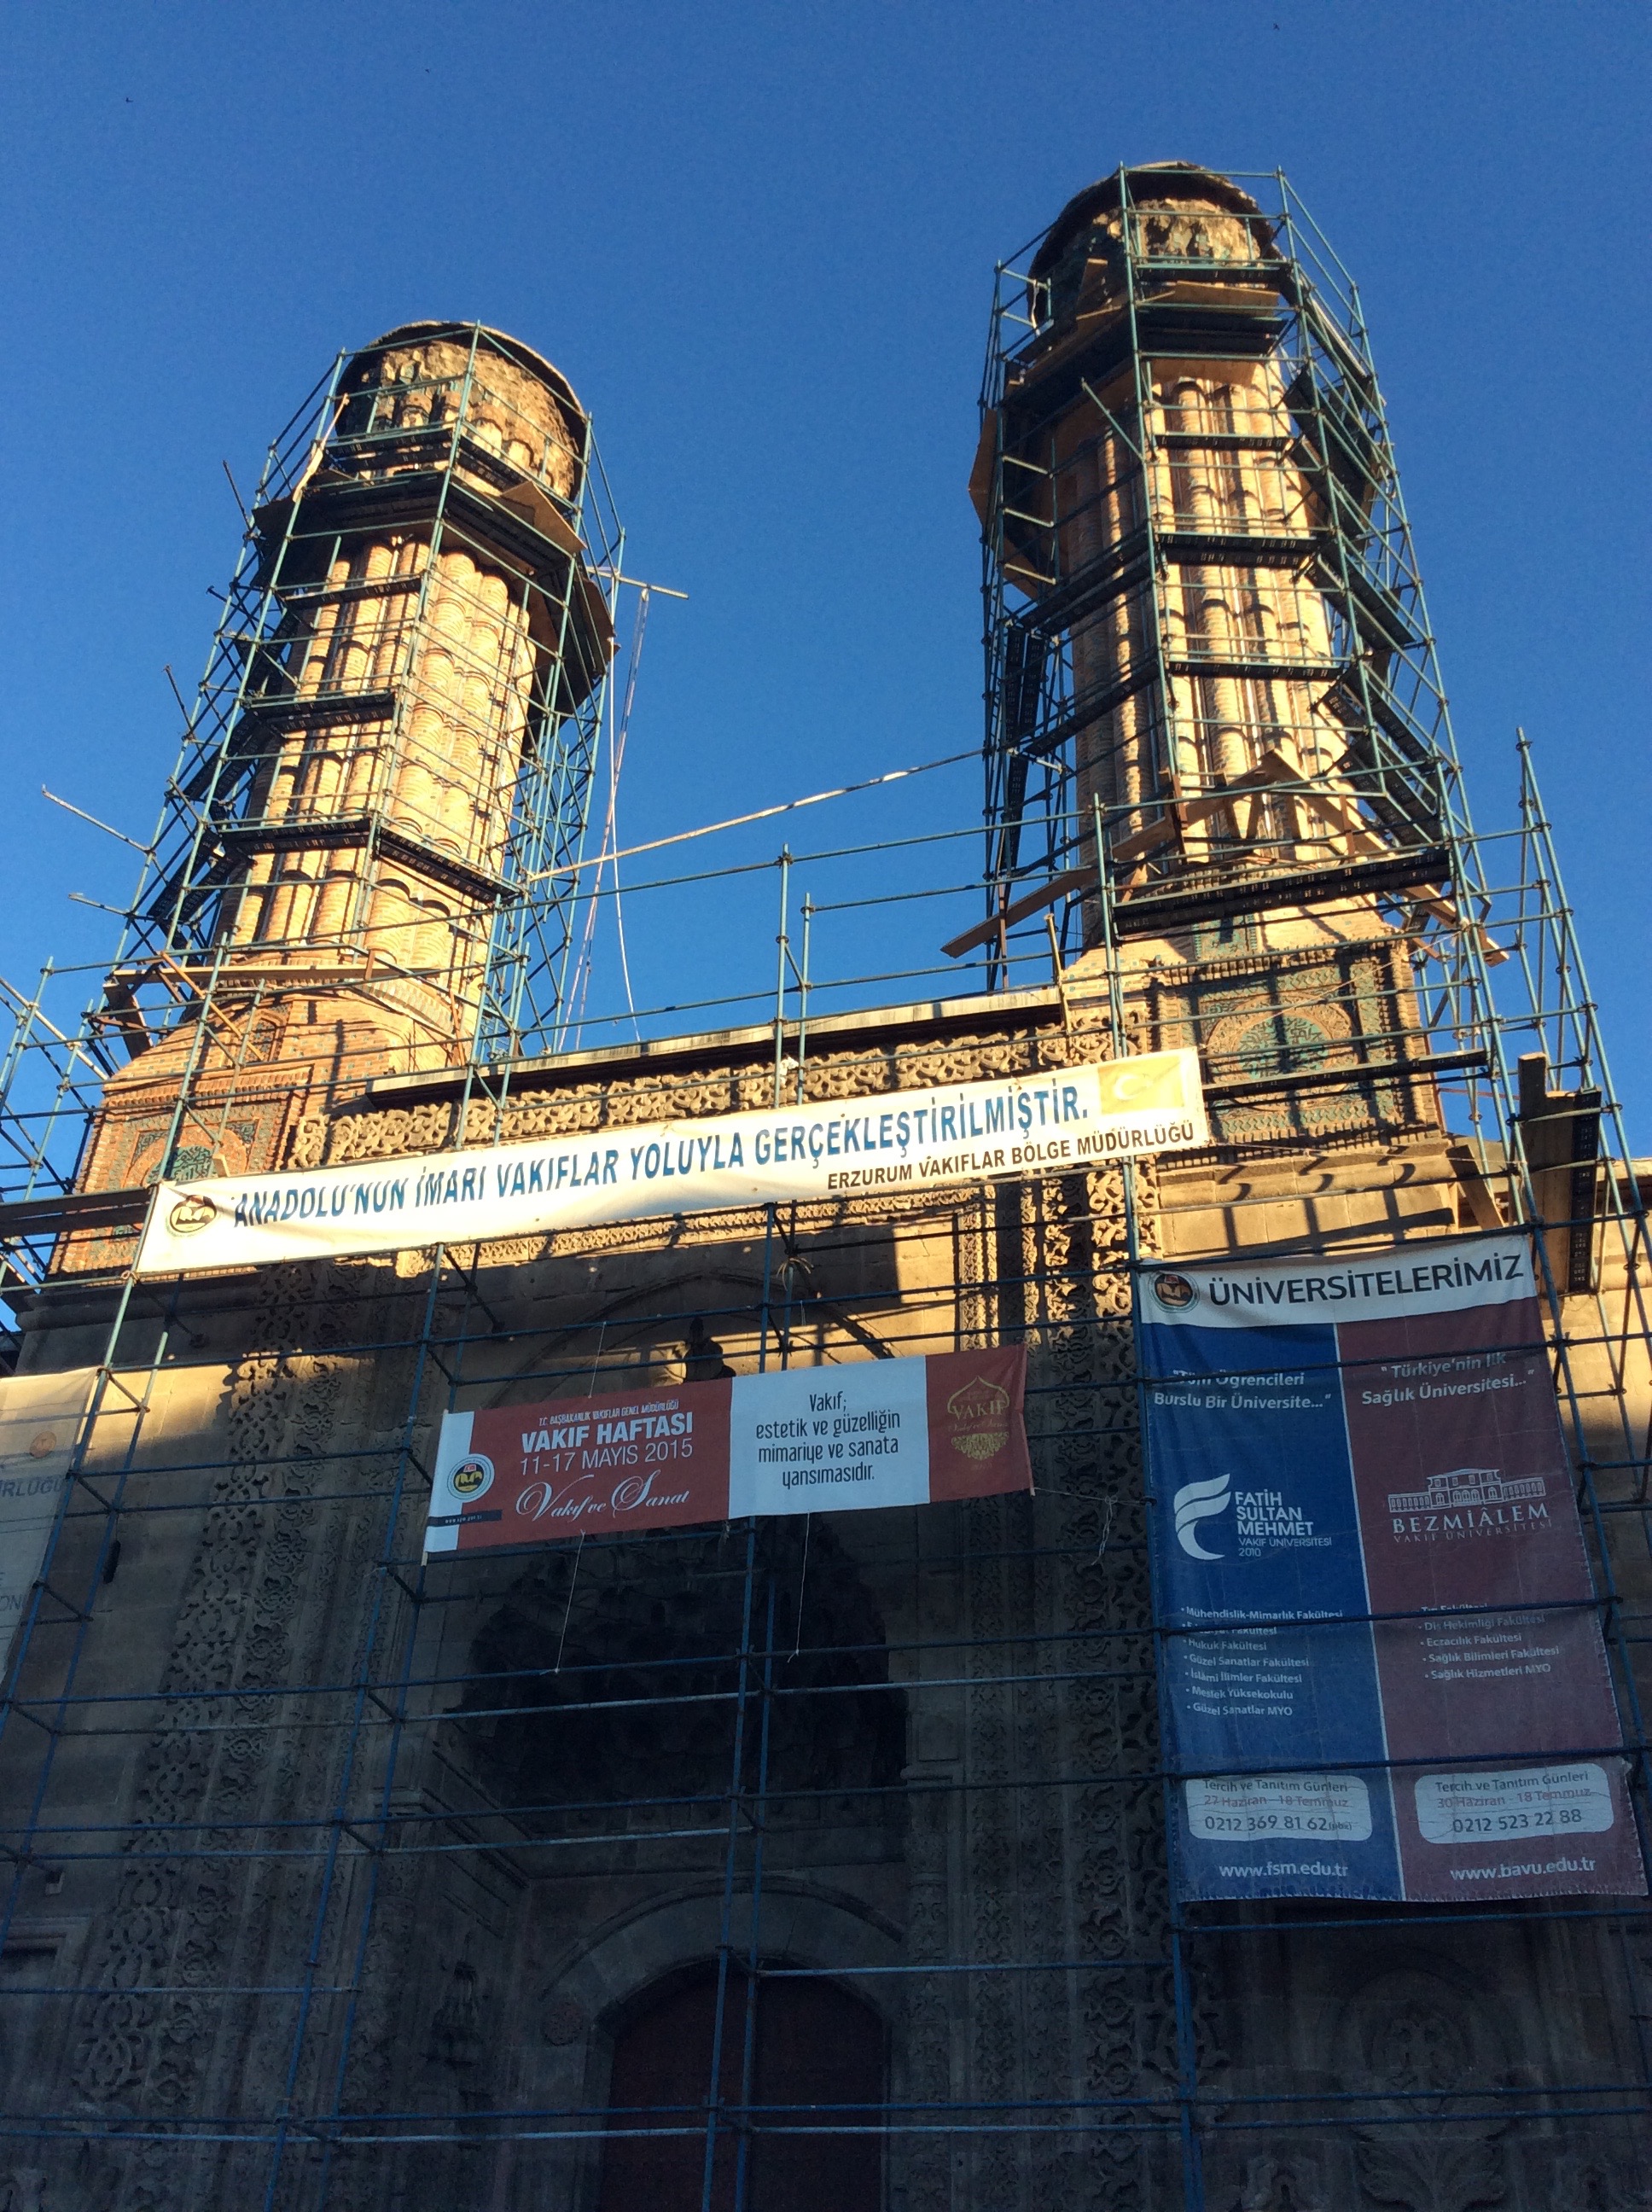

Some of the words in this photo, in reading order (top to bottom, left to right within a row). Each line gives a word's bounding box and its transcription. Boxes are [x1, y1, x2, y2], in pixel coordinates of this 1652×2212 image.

[234, 1177, 409, 1227] ANADOLU'NUN
[416, 1166, 485, 1208] İMARI
[497, 1150, 619, 1197] VAKIFLAR
[631, 1132, 743, 1179] YOLUYLA
[754, 1077, 1088, 1169] GERÇEKLEŞTİRİLMİŞTİR.
[828, 1163, 913, 1190] ERZURUM
[918, 1149, 1005, 1179] VAKIFLAR
[1011, 1138, 1071, 1164] BÖLGE
[1077, 1119, 1194, 1155] MÜDÜRLÜĞÜ
[1209, 1253, 1524, 1306] ÜNİVERSİTELERİMİZ
[810, 1391, 846, 1412] Vakıf;
[1155, 1392, 1201, 1406] Burslu
[1206, 1394, 1226, 1408] Bir
[1363, 1388, 1415, 1406] Sağlık
[952, 1400, 1006, 1420] VAKIF
[521, 1425, 590, 1453] VAKIF
[596, 1412, 693, 1445] HAFTASI
[757, 1418, 808, 1439] estetik
[813, 1420, 829, 1435] ve
[834, 1410, 900, 1437] güzelliğin
[521, 1452, 575, 1476] 11-17
[582, 1445, 638, 1470] MAYIS
[644, 1438, 693, 1463] 2015
[759, 1441, 823, 1464] mimariye
[828, 1443, 844, 1458] ve
[849, 1435, 899, 1457] sanata
[782, 1461, 875, 1489] yansımasıdır.
[515, 1474, 595, 1522] Vakıf
[587, 1501, 606, 1514] ve
[611, 1469, 689, 1518] Sanat
[1235, 1488, 1283, 1506] FATİH
[1236, 1506, 1302, 1521] SULTAN
[1393, 1503, 1550, 1534] BEZMİÂLEM
[1237, 1521, 1314, 1536] MEHMET
[1238, 1537, 1266, 1546] VAKIF
[1393, 1533, 1436, 1543] VAKIF
[1238, 1547, 1261, 1557] 2010
[1186, 1606, 1294, 1620] Mühendislik-Mimarlık
[1497, 1614, 1545, 1627] Fakültesi
[1189, 1639, 1219, 1650] Hukuk
[1222, 1640, 1267, 1651] Fakültesi
[1427, 1636, 1472, 1647] Eczacılık
[1475, 1632, 1522, 1644] Fakültesi
[1190, 1653, 1216, 1667] Güzel
[1219, 1656, 1260, 1667] Sanatlar
[1263, 1656, 1310, 1668] Fakültesi
[1428, 1652, 1462, 1665] Sağlık
[1464, 1649, 1509, 1662] Bilimleri
[1511, 1645, 1560, 1660] Fakültesi
[1256, 1674, 1303, 1684] Fakültesi
[1431, 1668, 1465, 1681] Sağlık
[1466, 1665, 1523, 1679] Hizmetleri
[1526, 1663, 1551, 1674] MYO
[1192, 1685, 1226, 1699] Meslek
[1228, 1688, 1294, 1700] Yüksekokulu
[1193, 1703, 1220, 1715] Güzel
[1223, 1703, 1265, 1715] Sanatlar
[1268, 1706, 1293, 1716] MYO
[1203, 1779, 1237, 1792] Tercih
[1240, 1781, 1252, 1790] ve
[1254, 1779, 1300, 1791] Tanıtım
[1304, 1780, 1347, 1792] Günleri
[1435, 1779, 1472, 1793] Tercih
[1476, 1781, 1490, 1790] ve
[1492, 1777, 1539, 1790] Tanıtım
[1542, 1771, 1588, 1784] Günleri
[1222, 1796, 1267, 1807] Haziran
[1280, 1795, 1293, 1805] 18
[1297, 1796, 1349, 1807] Temmuz
[1437, 1796, 1453, 1808] 30
[1455, 1796, 1505, 1807] Haziran
[1517, 1792, 1533, 1803] 18
[1534, 1788, 1591, 1802] Temmuz
[1205, 1815, 1242, 1831] 0212
[1248, 1814, 1277, 1831] 369
[1284, 1815, 1301, 1830] 81
[1453, 1818, 1492, 1833] 0212
[1498, 1814, 1529, 1831] 523
[1535, 1811, 1554, 1826] 22
[1560, 1808, 1583, 1824] 88
[1219, 1860, 1349, 1878] www.fsm.edu.tr
[1451, 1855, 1597, 1882] www.bavu.edu.tr
